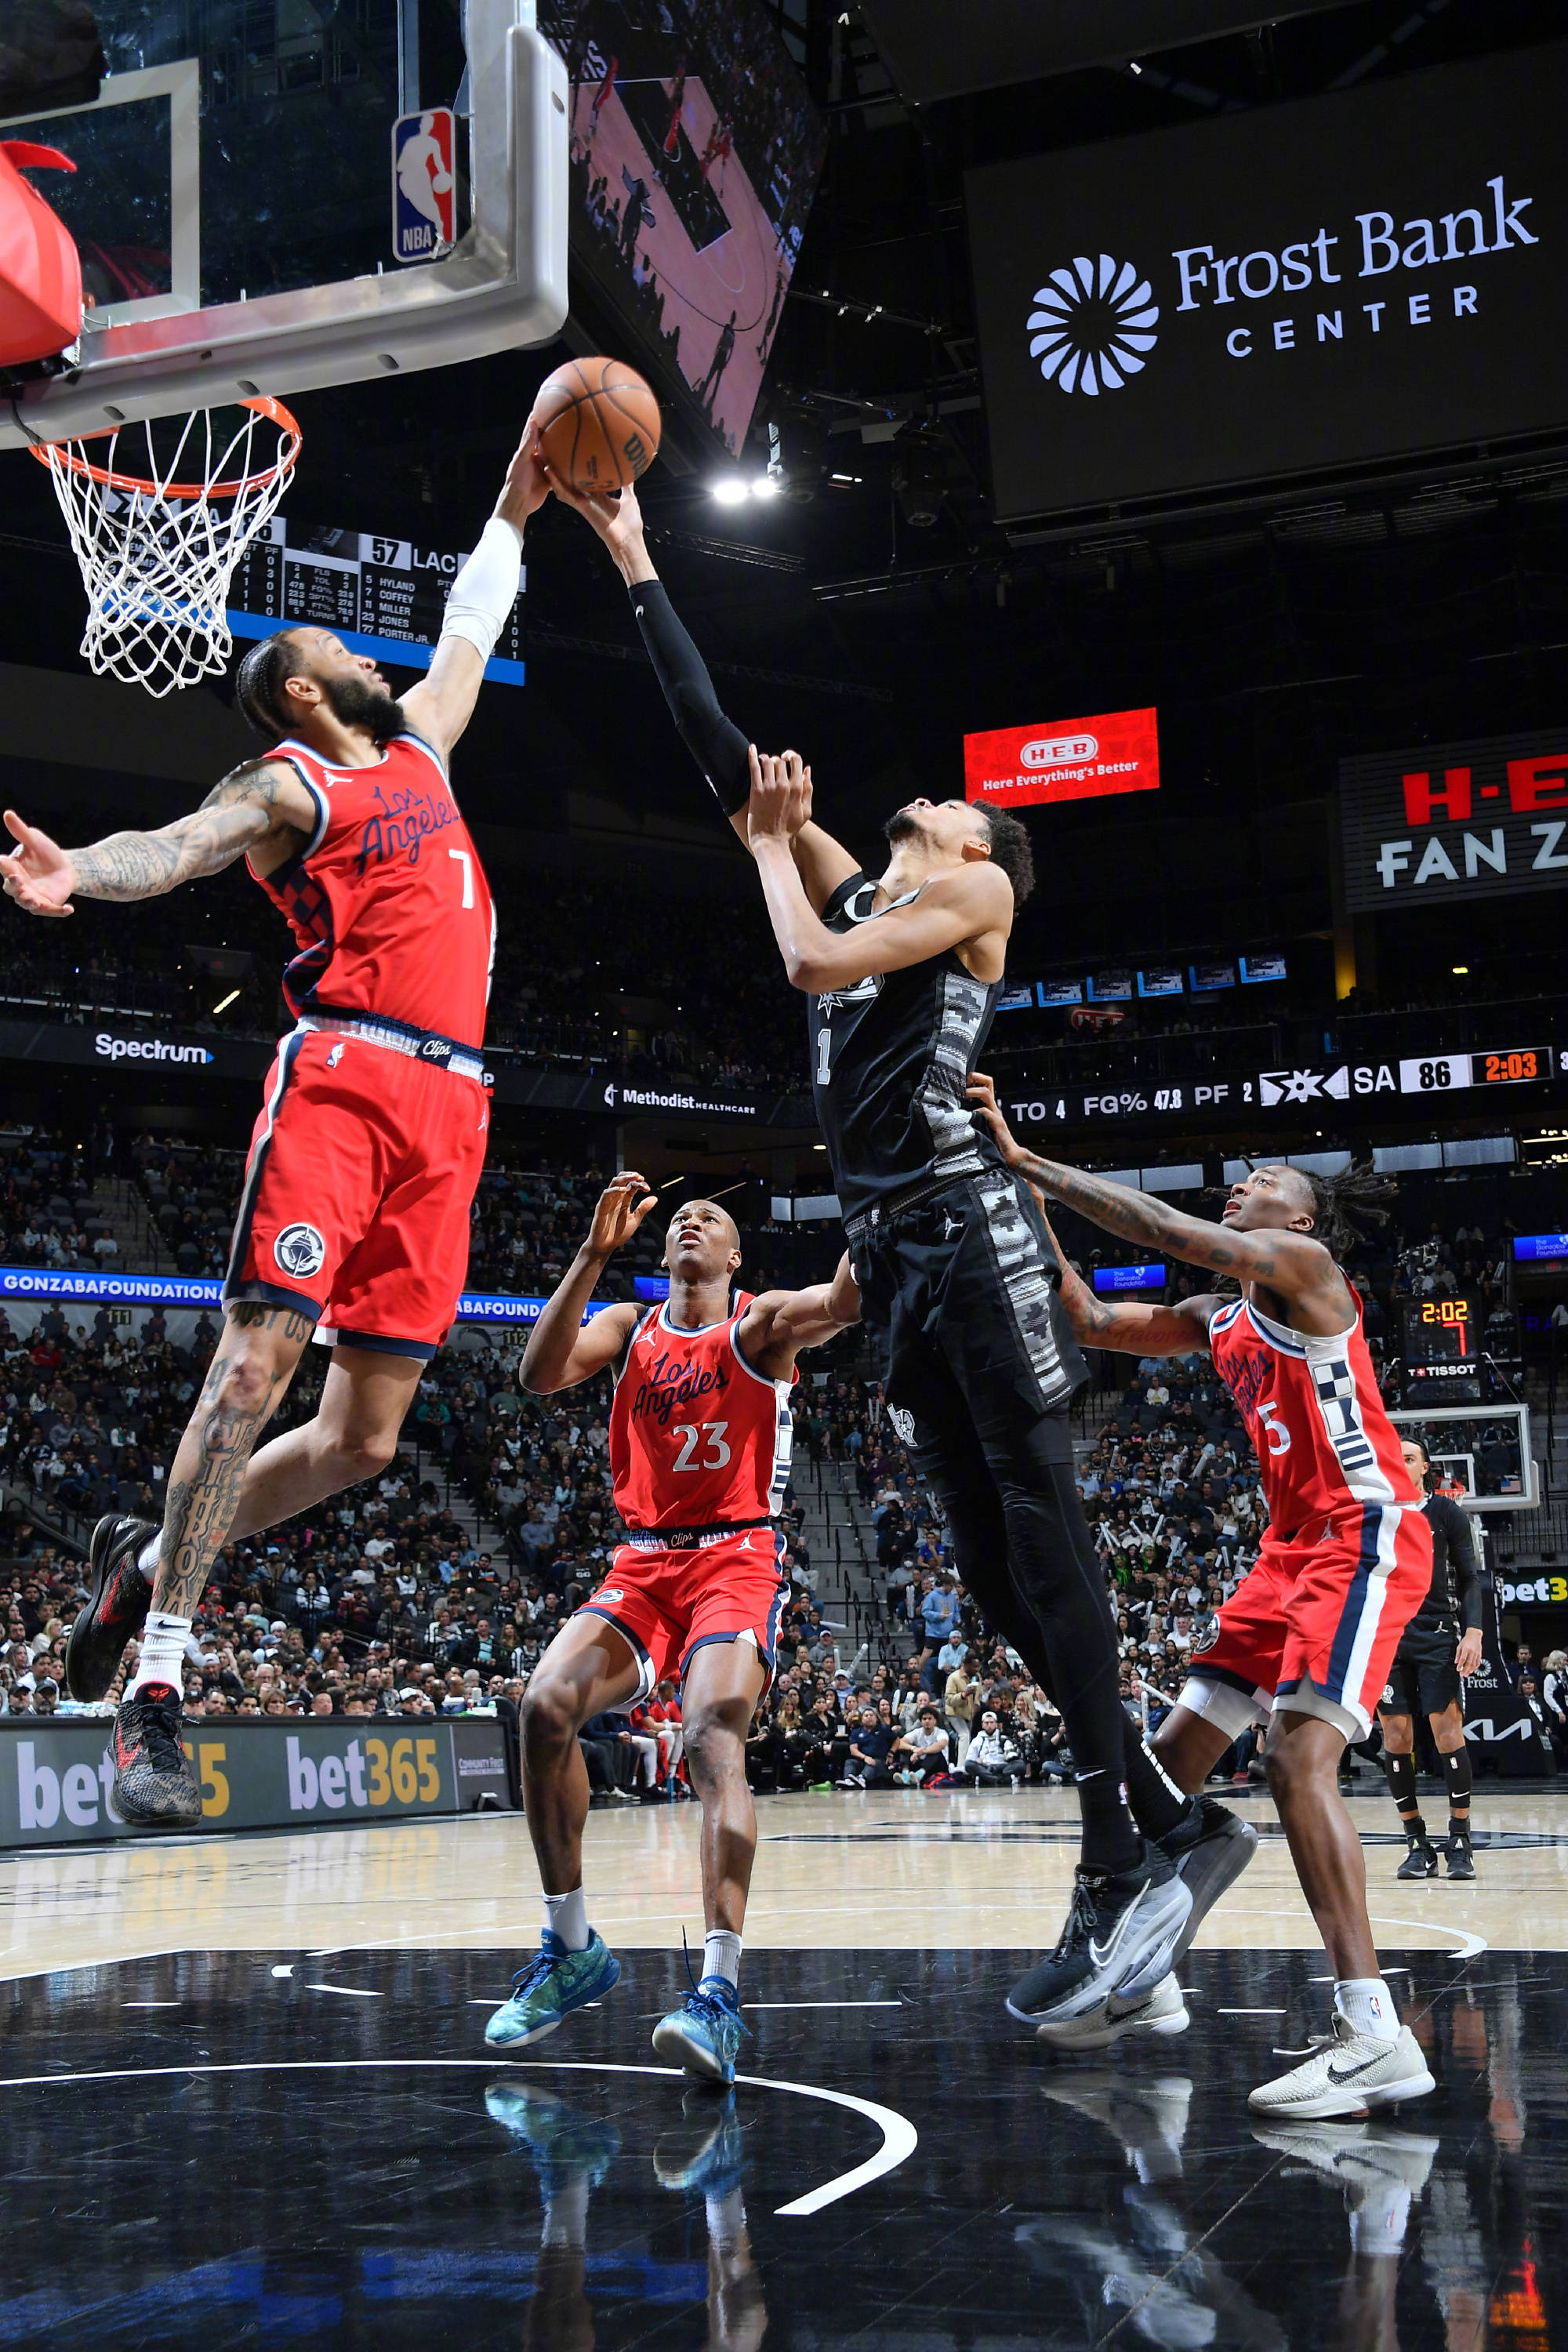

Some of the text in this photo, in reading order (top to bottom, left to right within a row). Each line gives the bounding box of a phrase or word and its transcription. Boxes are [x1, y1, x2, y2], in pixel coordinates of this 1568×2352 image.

[402, 224, 432, 252] NBA
[1171, 175, 1539, 312] Frost Bank
[1226, 285, 1479, 358] CENTER
[243, 552, 251, 561] 0
[267, 557, 274, 565] 0
[372, 538, 400, 565] 57
[412, 548, 456, 573] LAC
[242, 564, 250, 573] 4
[267, 569, 274, 578] 3
[314, 568, 331, 576] FLS
[244, 577, 249, 586] 1
[266, 581, 274, 590] 0
[289, 580, 305, 590] 47.8
[311, 585, 333, 595] FG%
[314, 576, 331, 586] TOL
[365, 575, 372, 584] 5
[379, 577, 416, 593] HYLAND
[437, 579, 453, 588] PT
[243, 590, 249, 599] 1
[266, 594, 274, 604] 0
[288, 589, 305, 599] 22.2
[365, 588, 415, 604] 7 COFFEY
[243, 602, 274, 616] 1 0
[293, 607, 299, 615] 5
[306, 609, 336, 621] TURNS
[311, 602, 332, 612] FT%
[365, 601, 412, 616] 11 MILLER
[513, 603, 517, 612] 1
[361, 612, 410, 629] 23 JONES
[361, 624, 374, 634] 77
[378, 627, 414, 642] PORTER
[511, 626, 519, 636] 0
[511, 639, 519, 648] 0
[983, 760, 1146, 791] Here Everything's Better
[373, 786, 423, 819] Los
[354, 793, 459, 877] Angeles
[1376, 821, 1568, 888] FAN Z
[448, 848, 474, 909] 7
[95, 1033, 207, 1065] Spectrum
[422, 1040, 452, 1059] Clips
[817, 1028, 832, 1086] 1
[1011, 1102, 1046, 1122] TO
[1055, 1099, 1066, 1120] 4
[1083, 1092, 1149, 1116] FG%
[1153, 1088, 1183, 1110] 47.8
[1194, 1083, 1229, 1105] PF
[1243, 1082, 1253, 1102] 2
[1353, 1065, 1396, 1094] SA
[1418, 1061, 1451, 1090] 86
[1485, 1051, 1537, 1082] 2:03
[622, 1088, 757, 1115] Methodist HEALTHCARE
[107, 1309, 130, 1324] 111
[1421, 1300, 1468, 1323] 2:02
[504, 1332, 527, 1345] 112
[1443, 1321, 1466, 1356] 7
[650, 1352, 694, 1387] Los
[1426, 1364, 1476, 1377] TISSOT
[633, 1366, 730, 1425] Angeles
[1256, 1400, 1291, 1456] 5
[673, 1421, 731, 1472] 23
[670, 1531, 694, 1548] Clips
[1467, 1676, 1498, 1689] Frost
[1461, 1718, 1533, 1741] KIA
[286, 1736, 441, 1811] bet365
[16, 1740, 230, 1830] bet5
